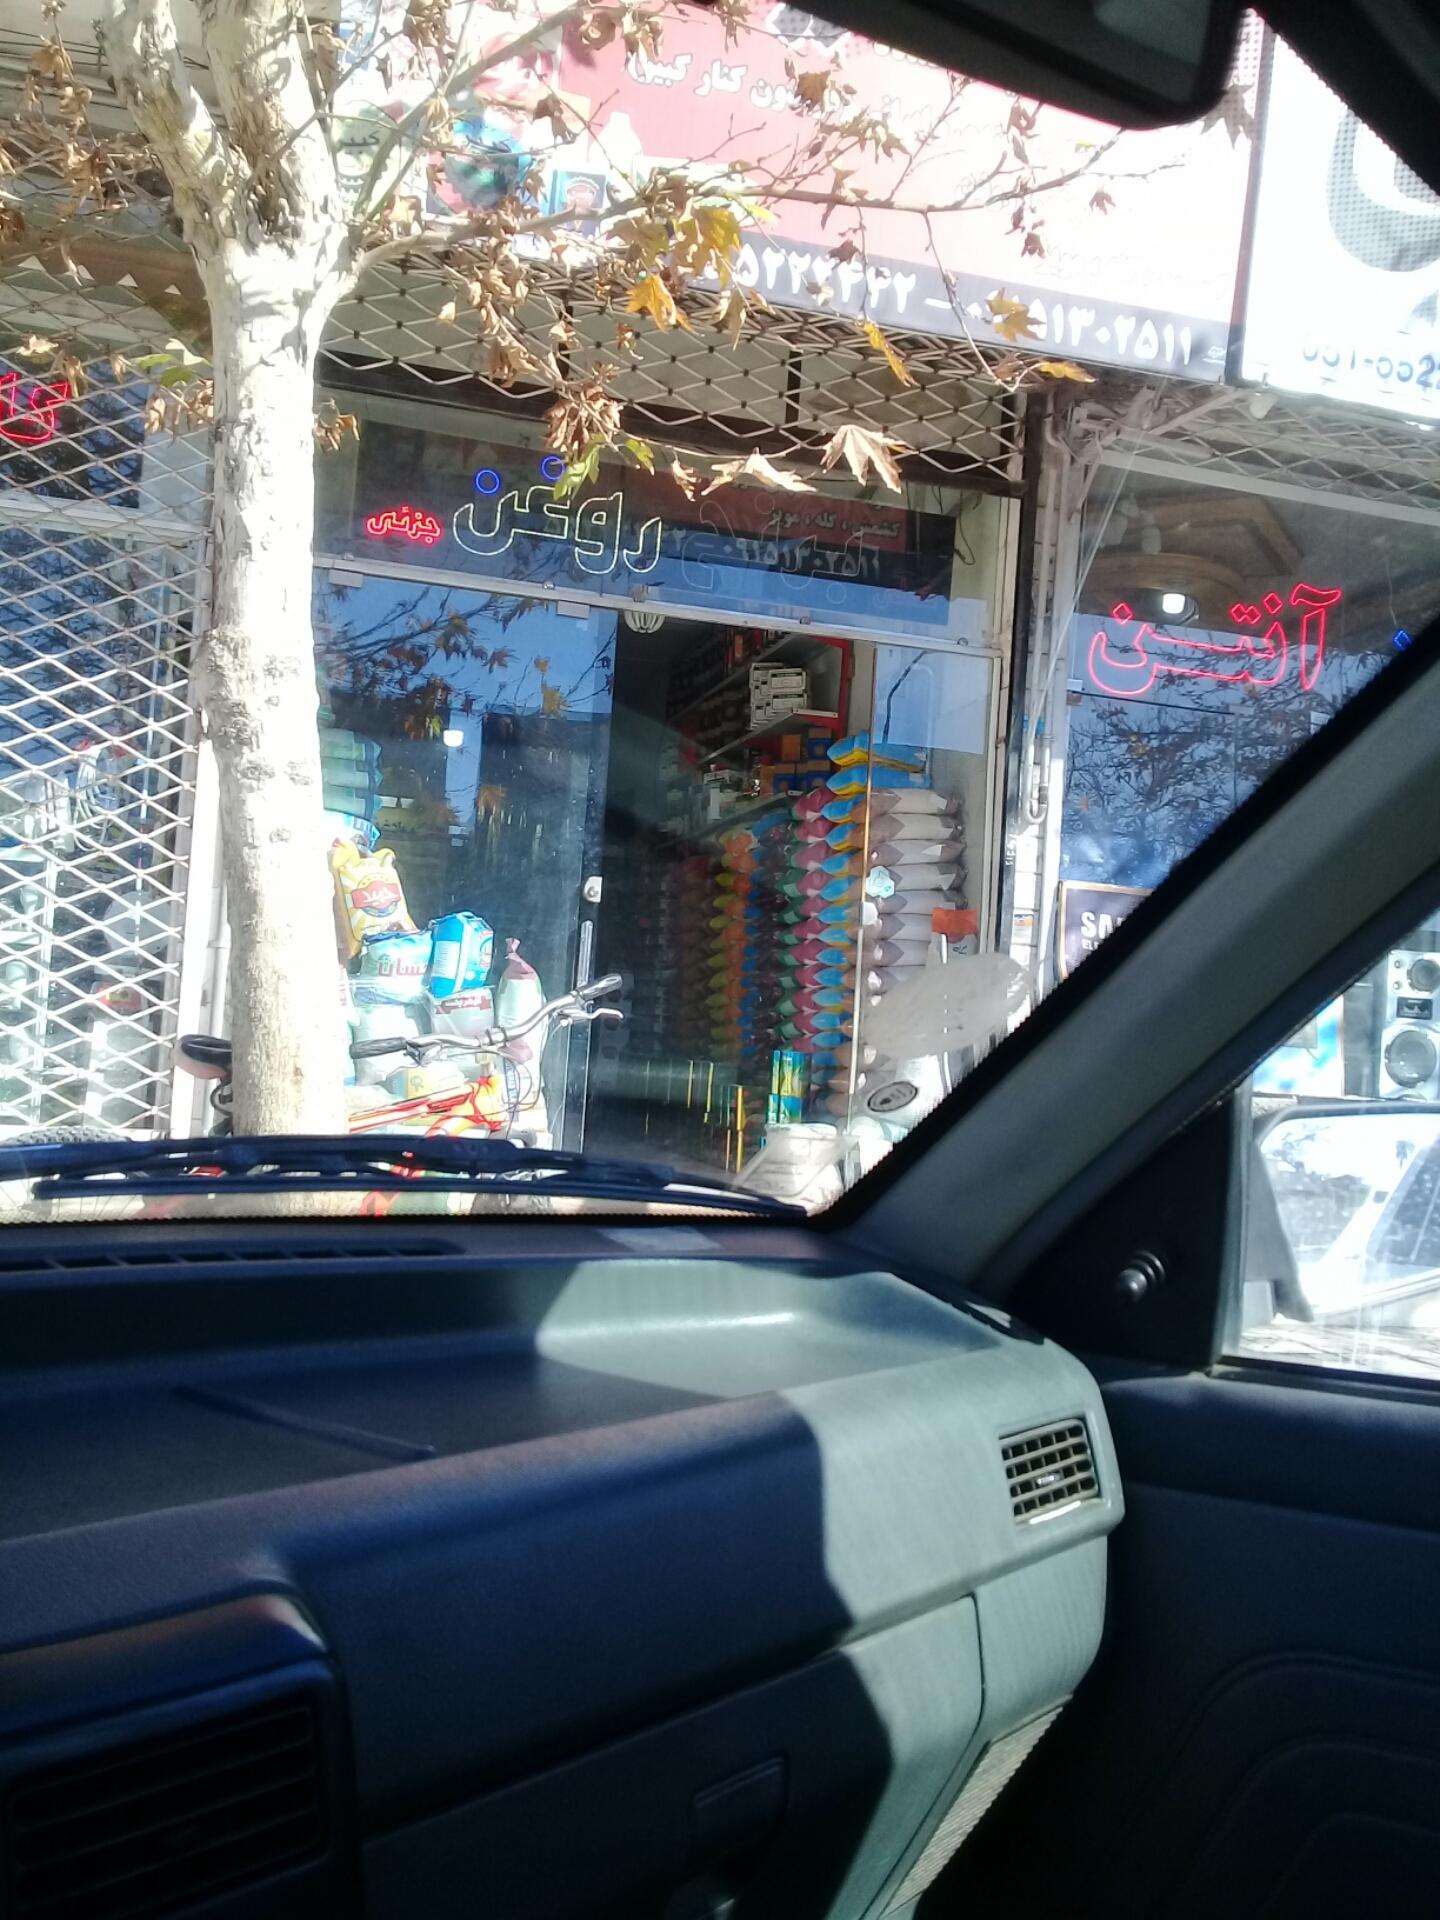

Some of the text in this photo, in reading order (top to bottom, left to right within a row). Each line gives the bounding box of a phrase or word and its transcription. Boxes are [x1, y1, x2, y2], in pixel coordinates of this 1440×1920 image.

[694, 59, 749, 96] کنار
[966, 290, 1192, 365] ۰۵۱۳۰۲۵۱۱
[453, 455, 662, 574] روغن
[1087, 581, 1343, 696] آنتن
[1081, 910, 1124, 940] SA
